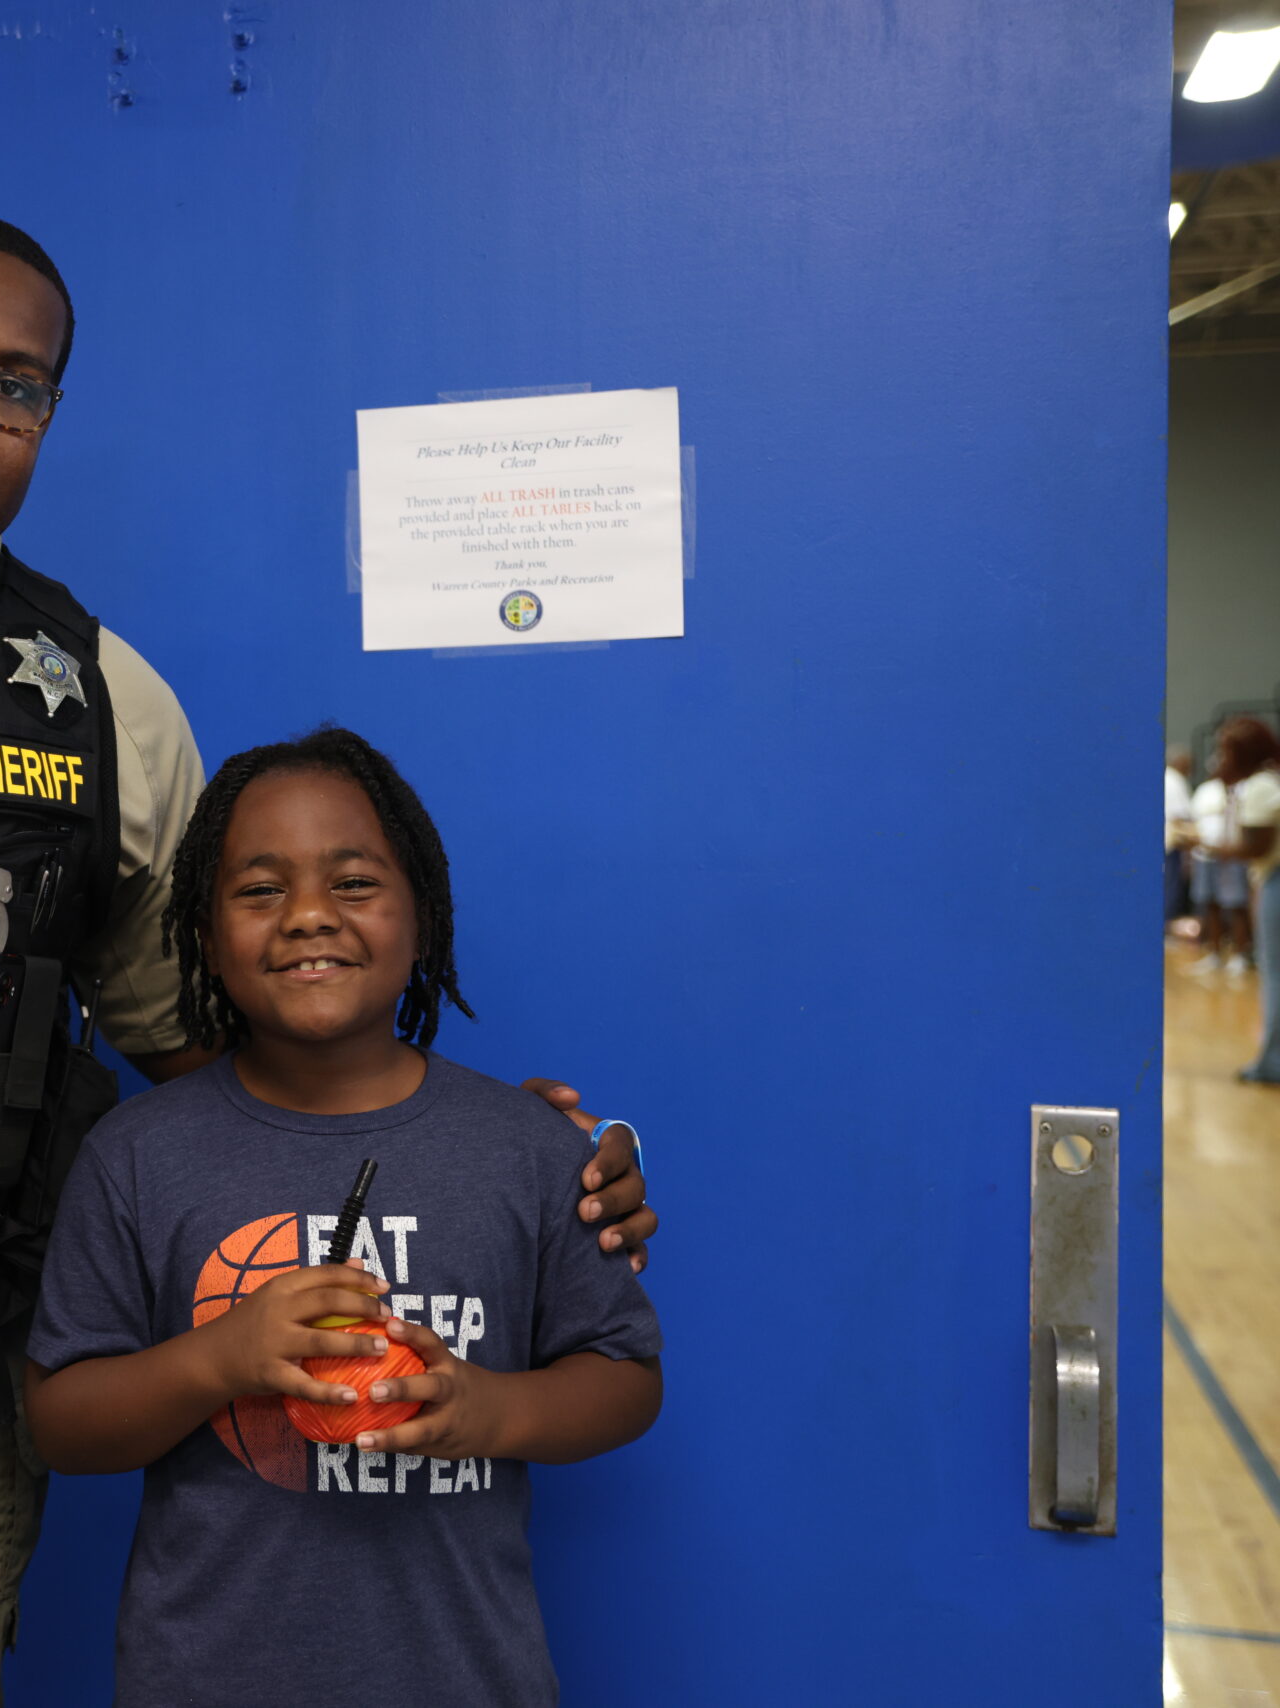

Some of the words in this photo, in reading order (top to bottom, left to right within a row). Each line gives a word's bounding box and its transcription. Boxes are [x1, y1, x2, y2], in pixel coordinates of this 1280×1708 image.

[417, 446, 455, 459] Please
[458, 443, 489, 458] Help
[491, 441, 509, 454] Us
[511, 440, 543, 455] Keep
[546, 437, 573, 450] Our
[574, 432, 623, 449] Facility
[500, 456, 537, 470] Clean
[404, 494, 442, 508] Throw
[447, 494, 477, 506] away
[480, 490, 506, 504] ALL
[509, 486, 556, 502] TRASH
[559, 486, 571, 499] in
[573, 483, 605, 498] trash
[607, 484, 635, 496] cans
[399, 510, 451, 529] provided
[453, 508, 475, 521] and
[477, 507, 509, 523] place
[512, 504, 537, 518] ALL
[541, 501, 592, 516] TABLES
[594, 498, 623, 513] back
[625, 500, 642, 511] on
[410, 528, 429, 541] the
[432, 524, 485, 543] provided
[487, 521, 517, 536] table
[519, 520, 546, 534] rack
[549, 518, 583, 532] when
[585, 519, 608, 534] you
[610, 518, 629, 529] are
[462, 538, 509, 554] finished
[512, 537, 540, 551] with
[543, 535, 577, 549] them.
[495, 559, 524, 571] Thank
[526, 560, 548, 572] you,
[431, 581, 469, 592] Warren
[471, 580, 506, 592] County
[509, 577, 537, 588] Parks
[540, 575, 559, 587] and
[560, 574, 614, 586] Recreation
[306, 1214, 418, 1284] EAT
